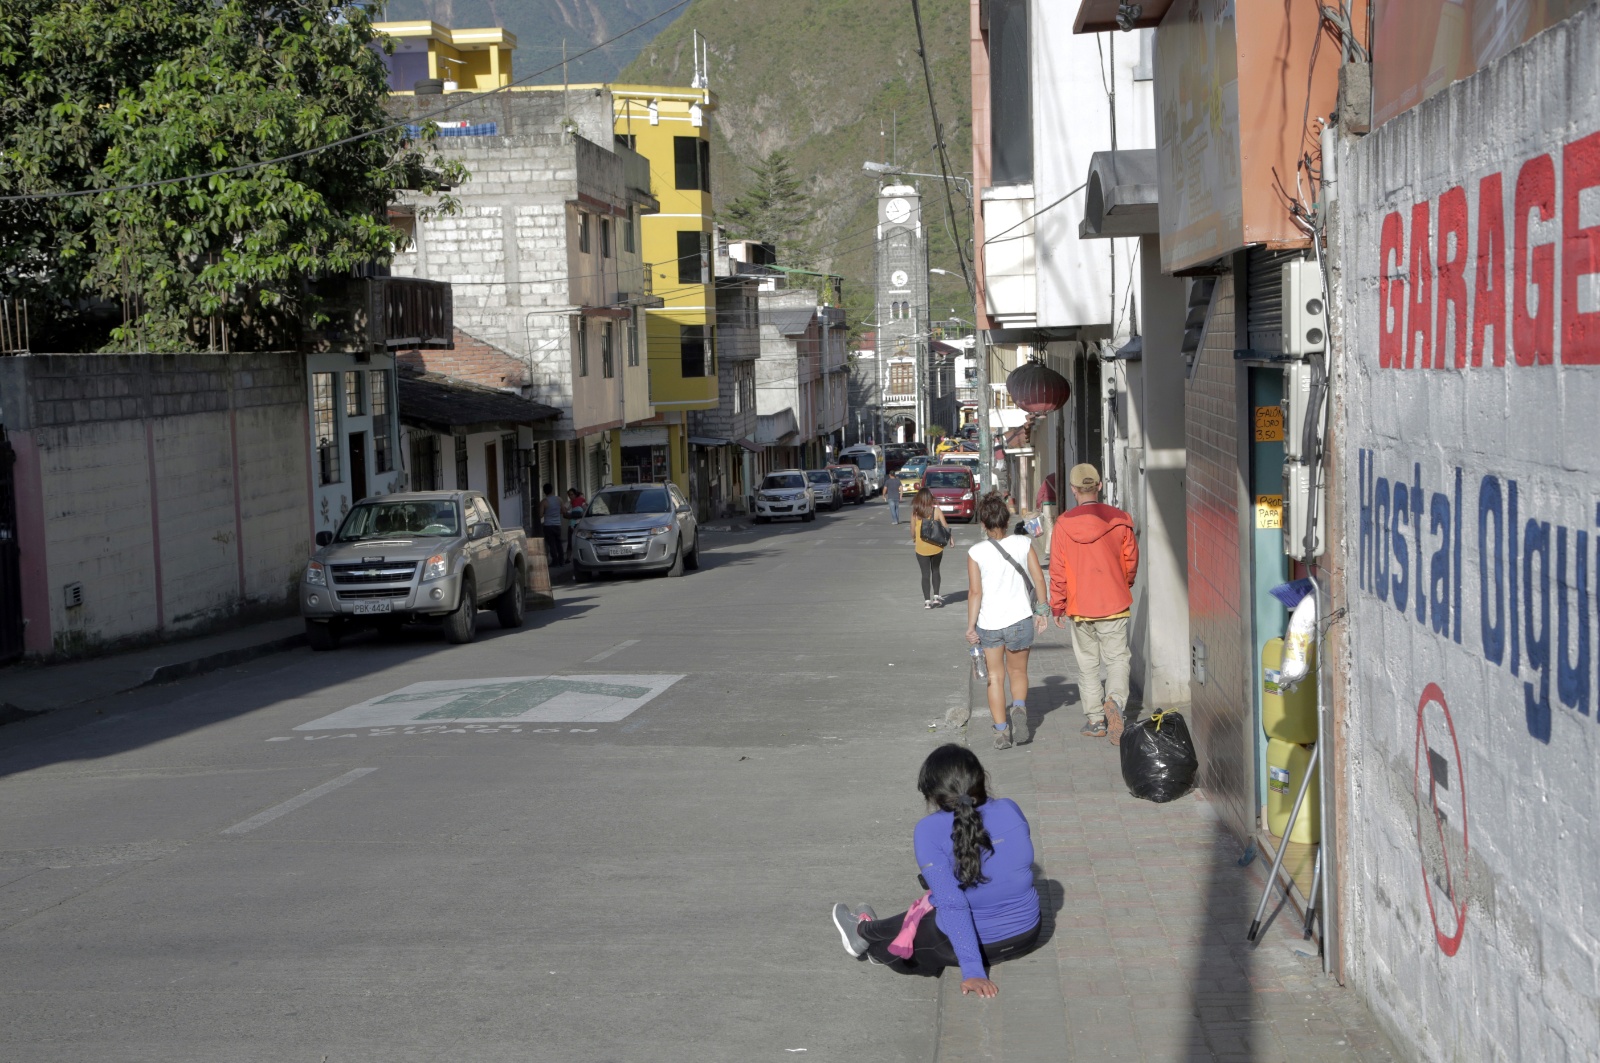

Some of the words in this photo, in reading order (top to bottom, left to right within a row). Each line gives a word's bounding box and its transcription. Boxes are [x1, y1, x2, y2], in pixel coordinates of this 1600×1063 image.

[1379, 129, 1600, 370] GARAGE
[1258, 508, 1279, 518] PARA
[1358, 448, 1463, 645] Hostal
[354, 603, 390, 613] PBK-4424
